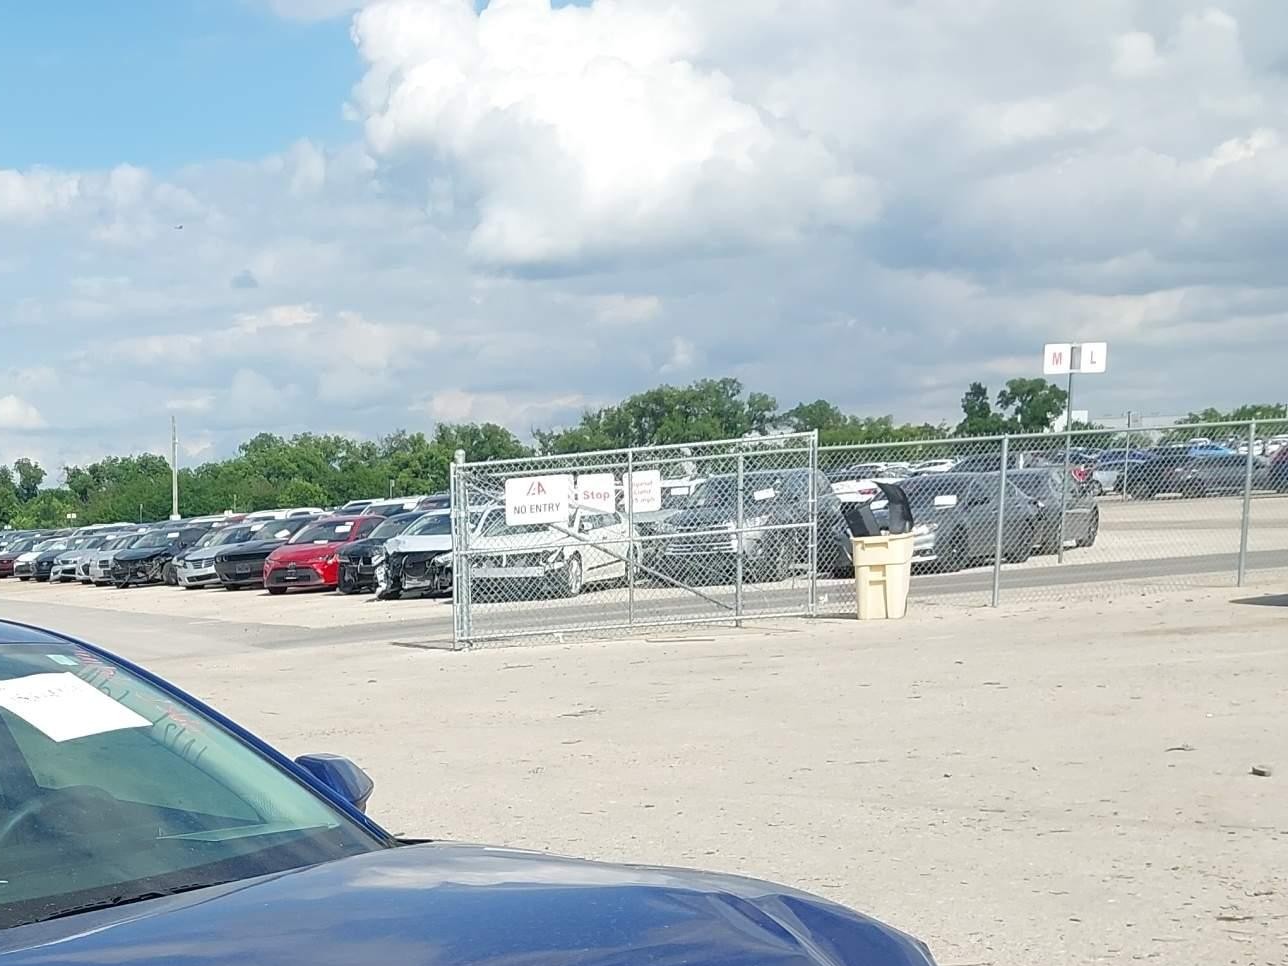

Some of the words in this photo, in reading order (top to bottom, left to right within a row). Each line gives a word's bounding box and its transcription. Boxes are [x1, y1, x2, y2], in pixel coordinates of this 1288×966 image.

[1052, 352, 1063, 366] M
[1089, 351, 1097, 365] L
[583, 490, 610, 502] Stop
[513, 504, 527, 515] NO
[529, 502, 561, 514] ENTRY
